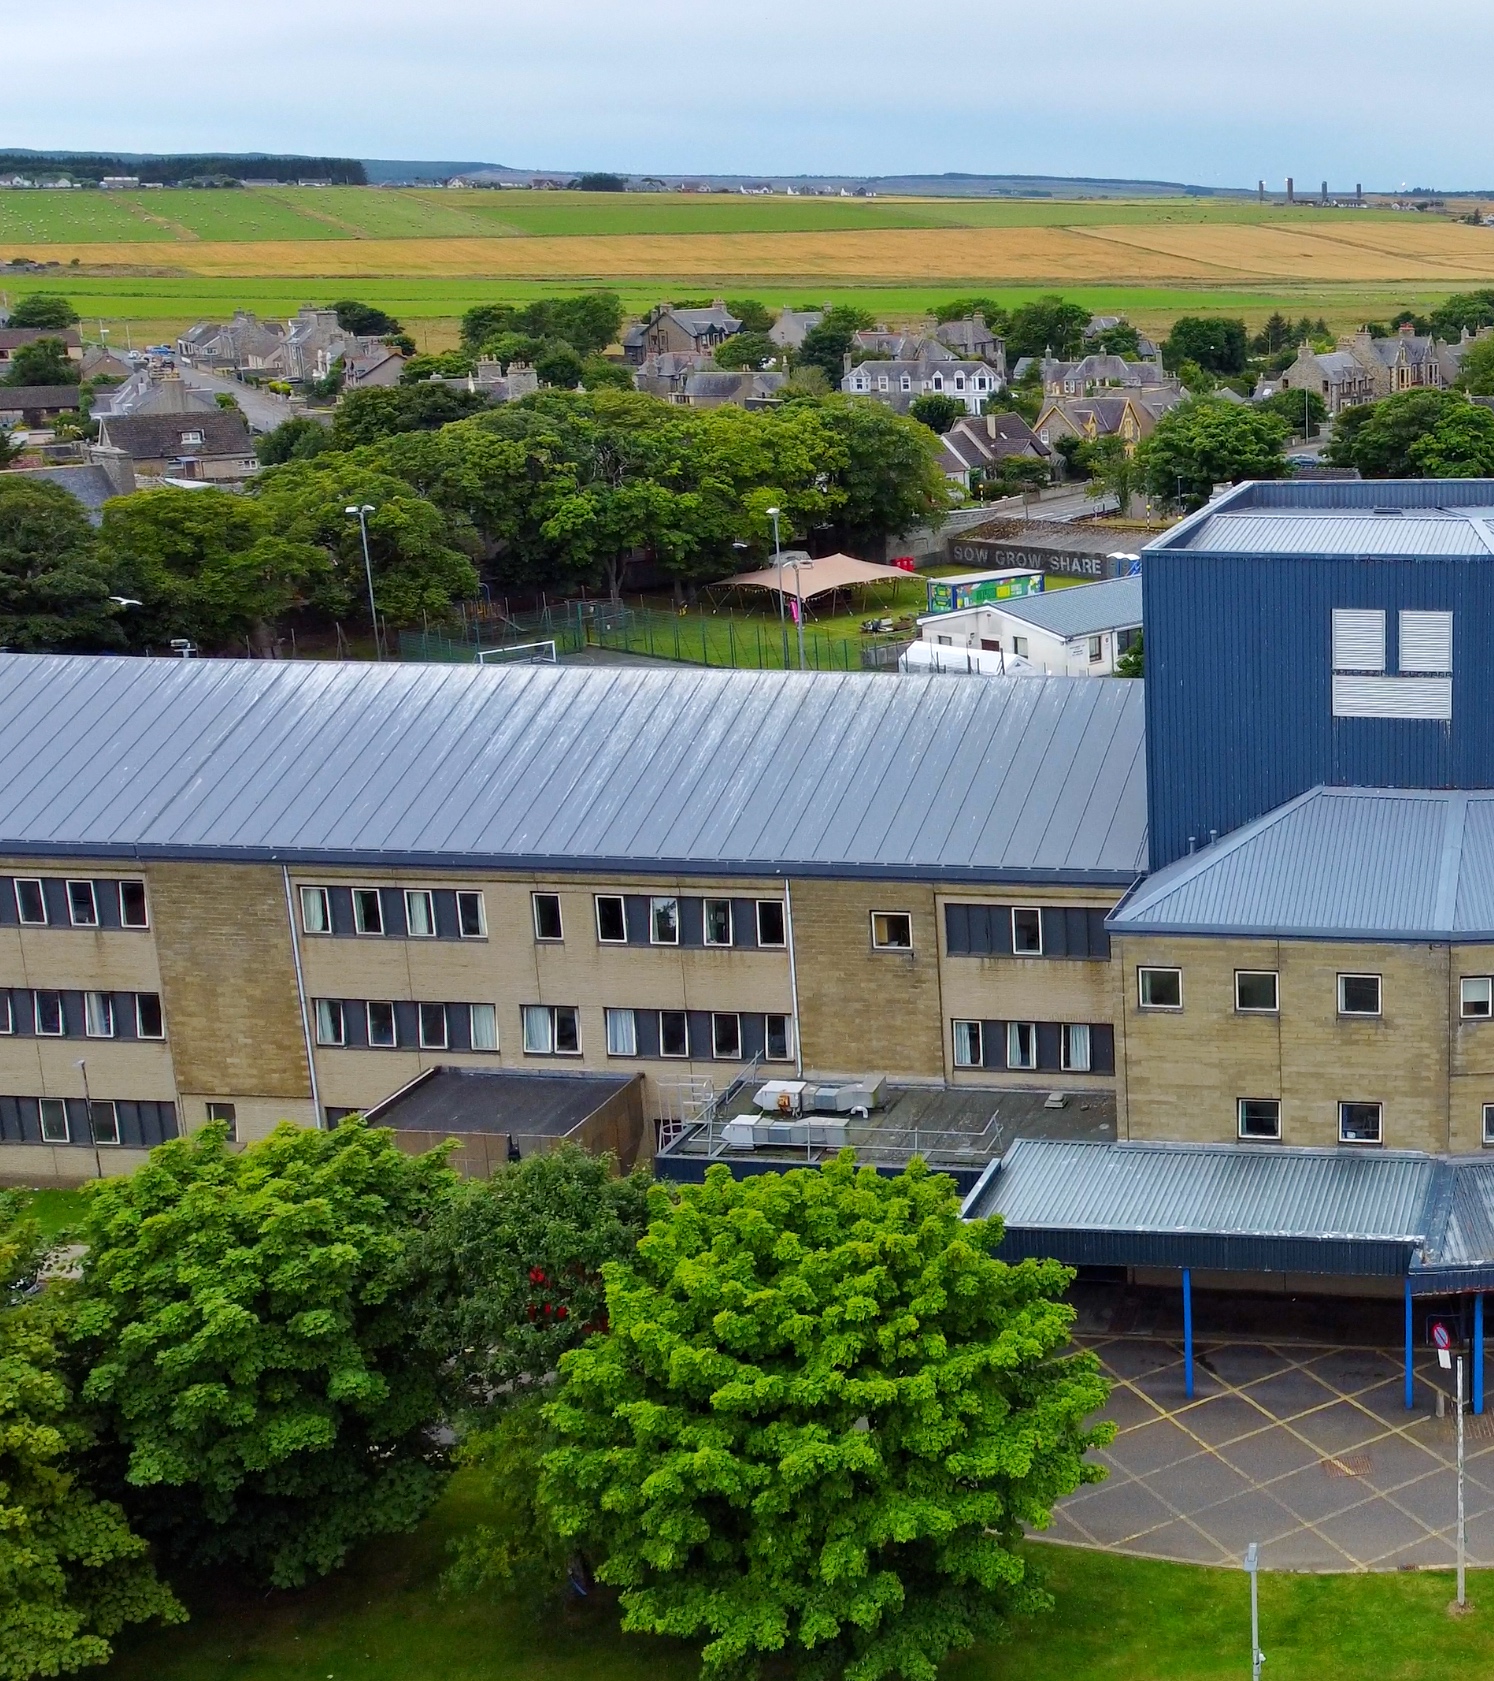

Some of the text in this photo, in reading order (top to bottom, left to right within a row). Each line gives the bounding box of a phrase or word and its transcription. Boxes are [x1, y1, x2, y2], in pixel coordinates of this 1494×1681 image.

[953, 546, 1102, 575] SOW GROW SHARE
